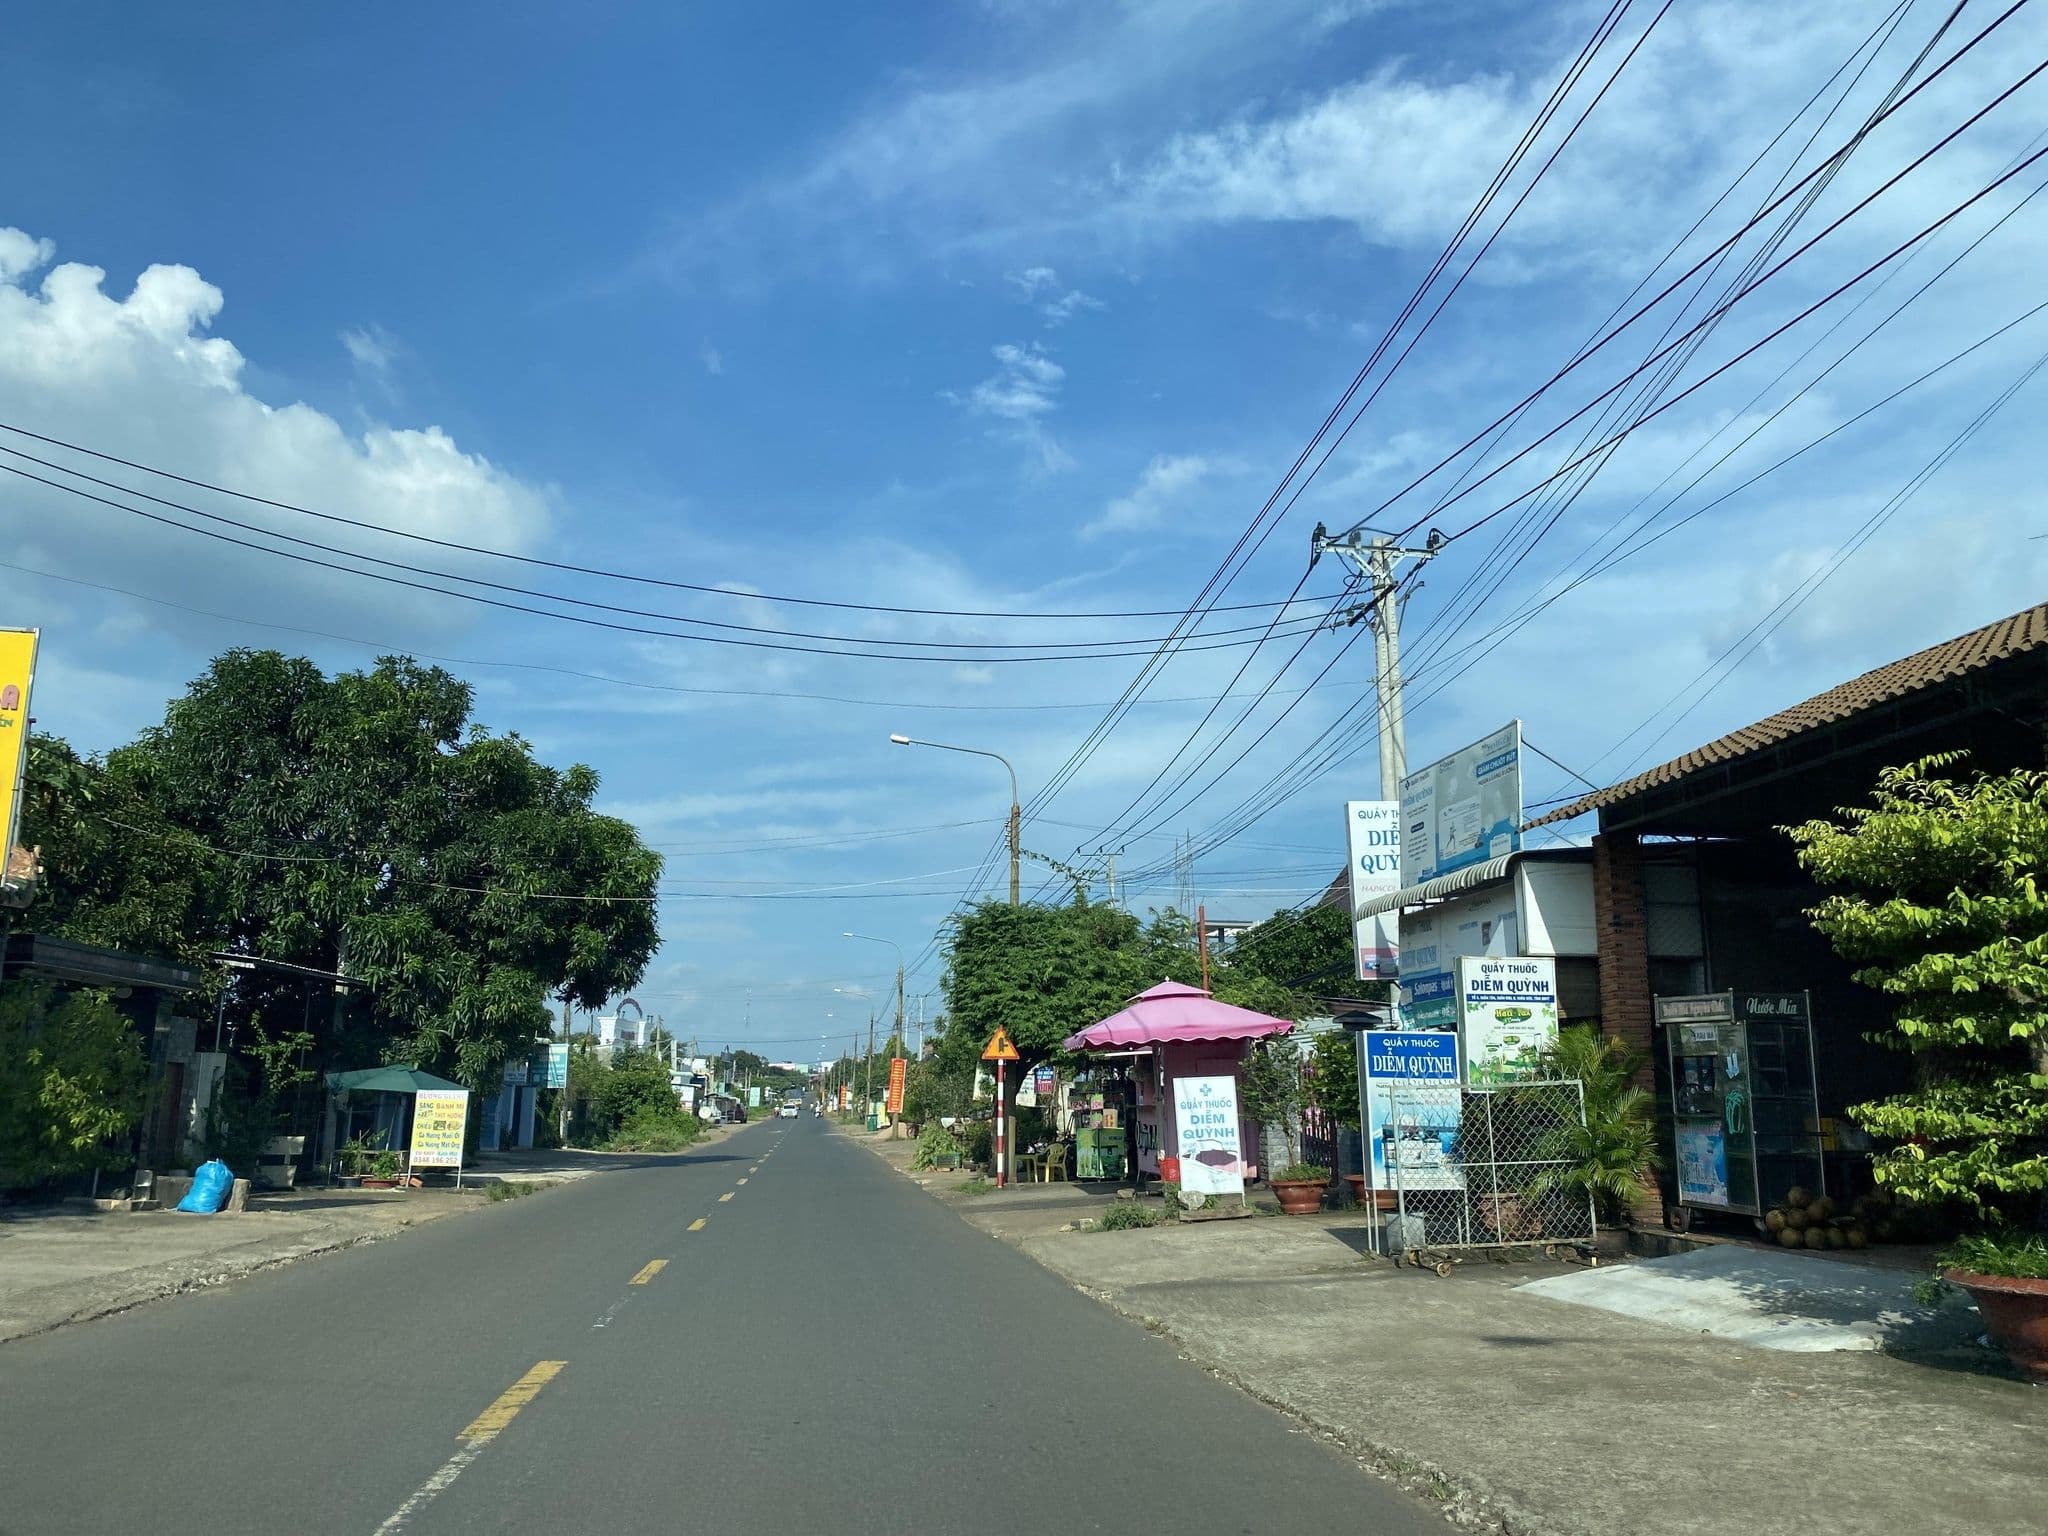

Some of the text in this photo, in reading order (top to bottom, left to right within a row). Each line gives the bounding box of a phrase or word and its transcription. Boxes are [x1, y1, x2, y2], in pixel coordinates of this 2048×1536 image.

[1368, 822, 1400, 847] DIỄ
[1361, 850, 1400, 875] QUỲ
[1508, 962, 1538, 974] THUỐC
[1471, 974, 1503, 992] DIỄM
[1507, 977, 1549, 993] QUỲNH
[1410, 1037, 1440, 1048] THUỐC
[1372, 1047, 1453, 1076] DIỄM QUỲNH
[1204, 1096, 1233, 1109] THUỐC
[1190, 1110, 1225, 1125] DIỄM
[1183, 1126, 1235, 1139] QUỲNH
